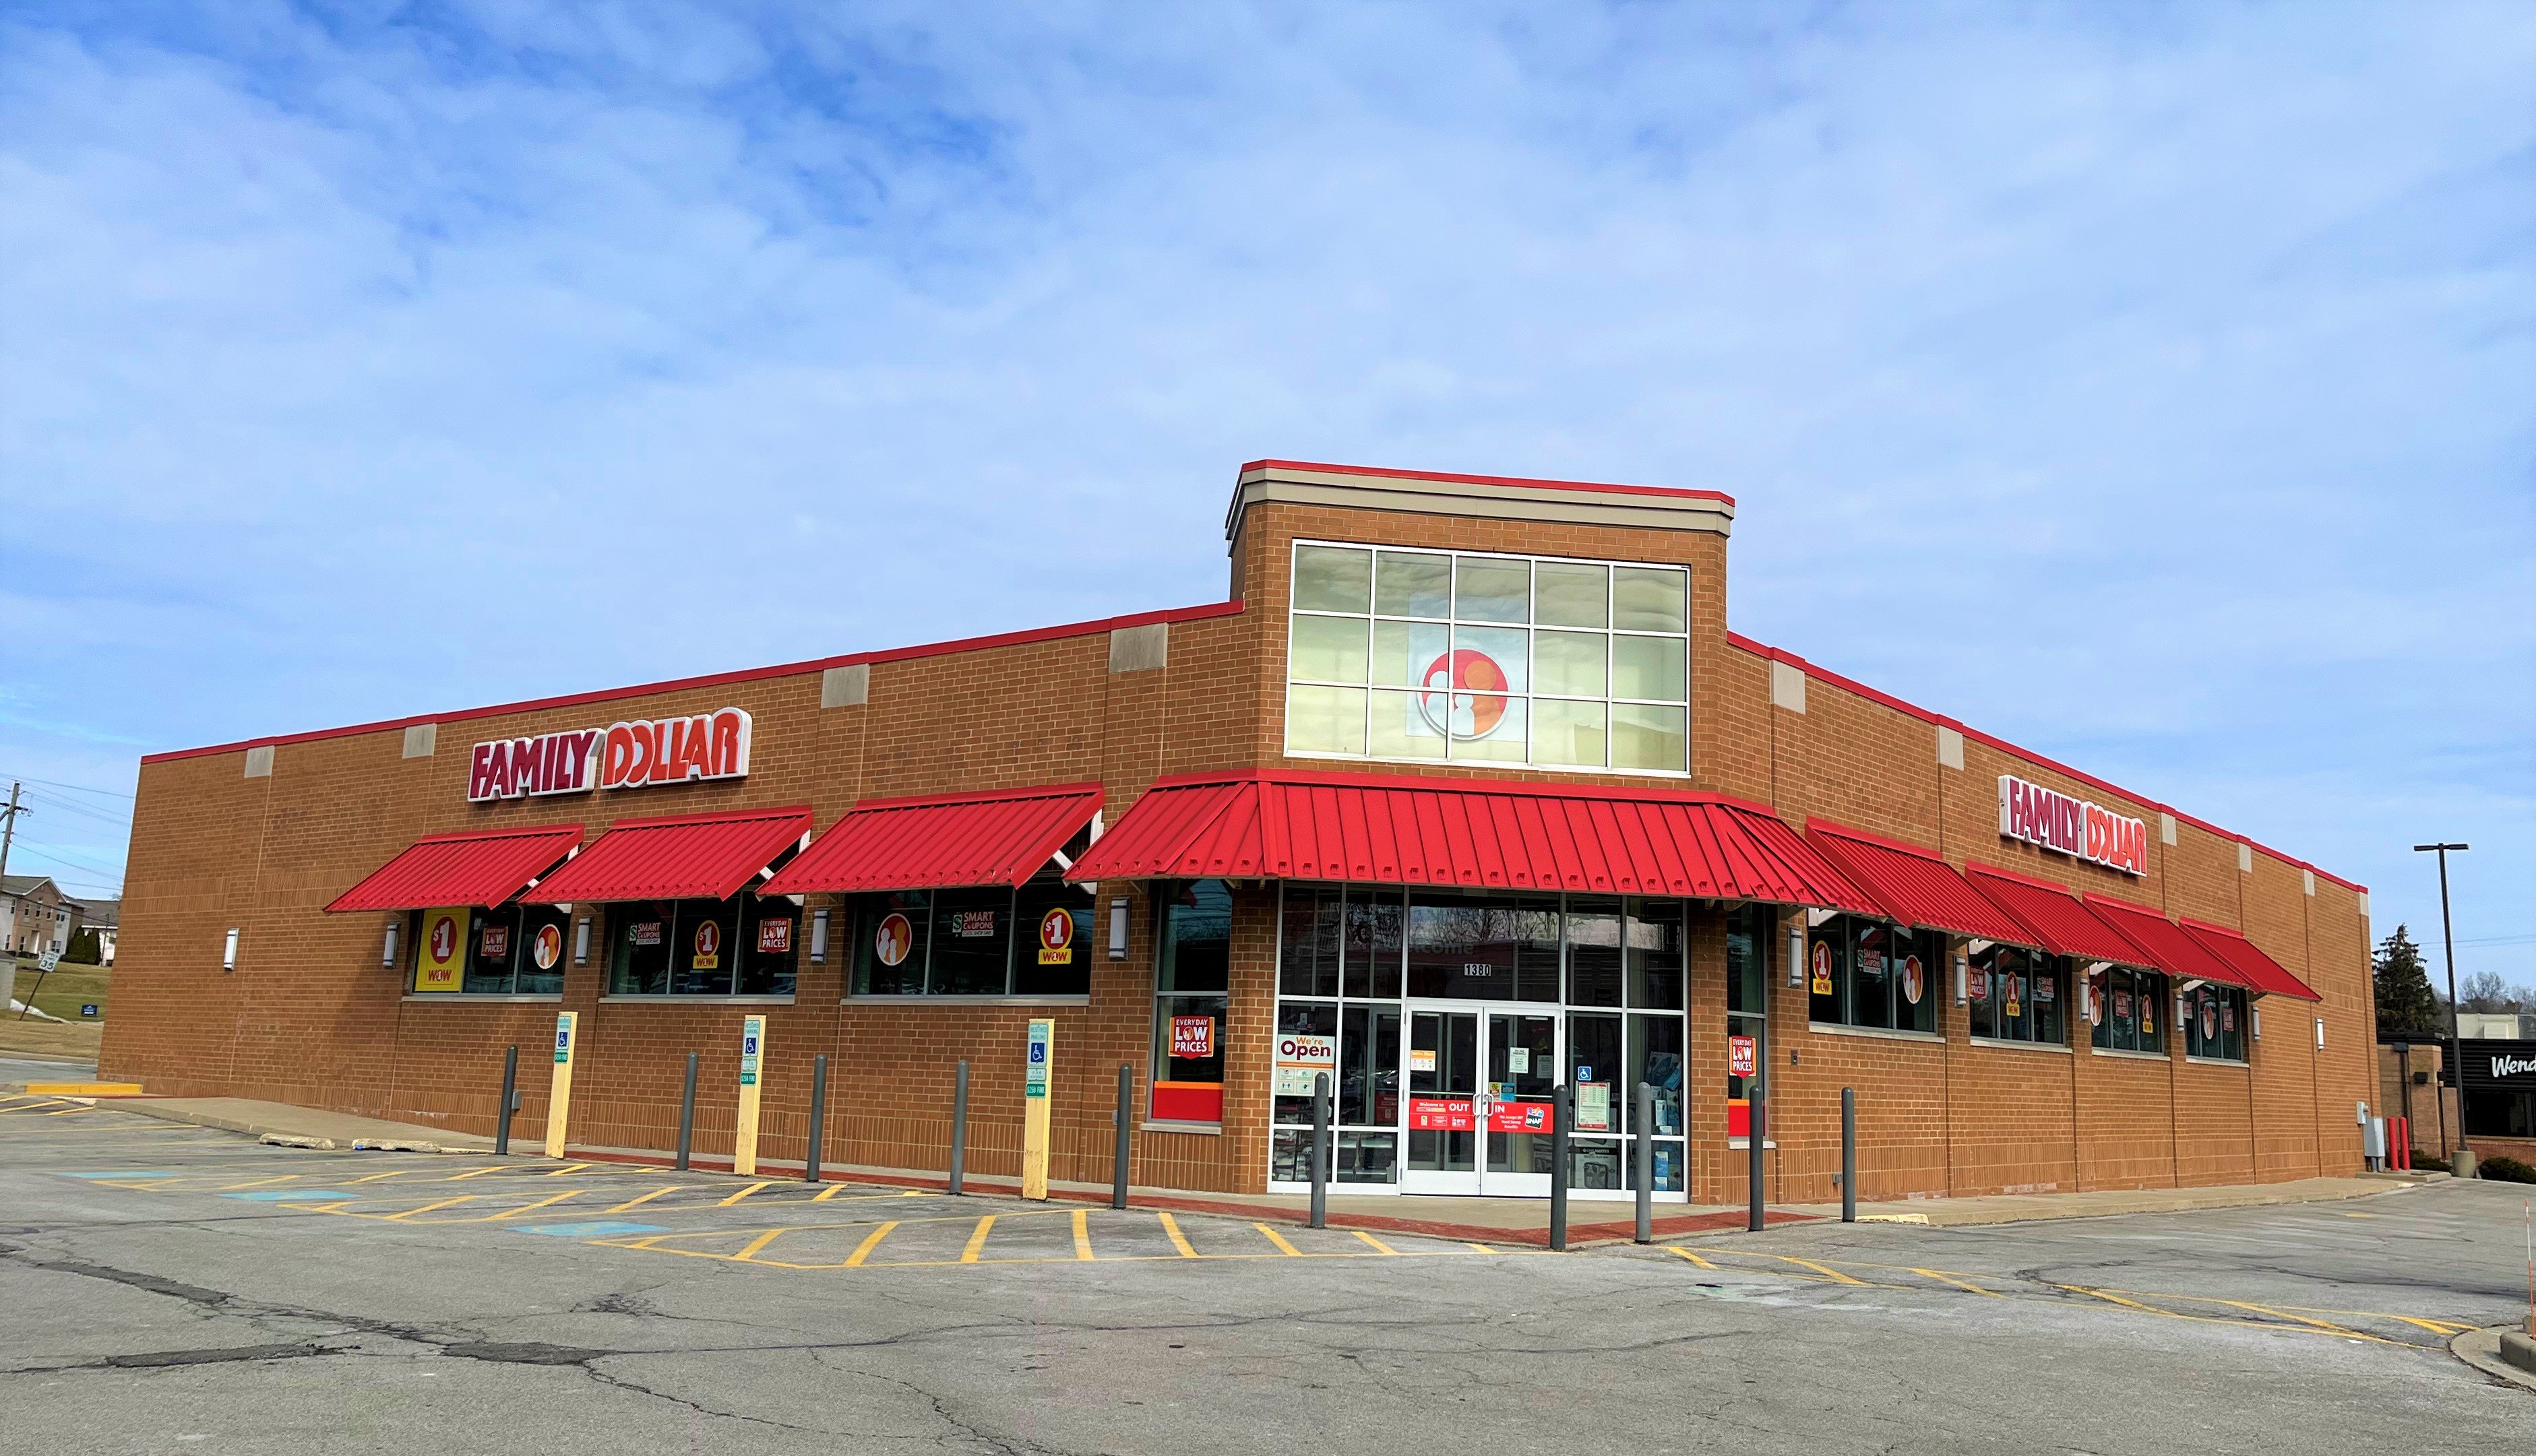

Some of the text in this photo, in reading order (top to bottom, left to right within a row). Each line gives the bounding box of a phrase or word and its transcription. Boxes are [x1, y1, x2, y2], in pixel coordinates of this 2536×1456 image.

[470, 711, 741, 798] FAMILY DOLLAR
[2010, 779, 2146, 874] FAMILY DOLLAR
[964, 910, 994, 922] SMART
[763, 926, 786, 939] LOW
[1045, 914, 1063, 943] $1
[433, 921, 450, 957] $1
[486, 933, 505, 944] LOW
[699, 926, 712, 951] $1
[762, 939, 786, 947] PRICES
[485, 945, 503, 953] PRICES
[1043, 952, 1067, 961] WOW
[1816, 947, 1827, 975] $1
[40, 960, 54, 970] 35
[1466, 964, 1490, 975] 1380
[1175, 1026, 1208, 1040] LOW
[1296, 1036, 1324, 1045] We're
[1175, 1042, 1207, 1052] PRICES
[1281, 1040, 1330, 1060] Open
[1733, 1046, 1752, 1061] LOW
[1733, 1061, 1752, 1071] PRICES
[1449, 1103, 1469, 1112] OUT
[1495, 1105, 1505, 1113] IN
